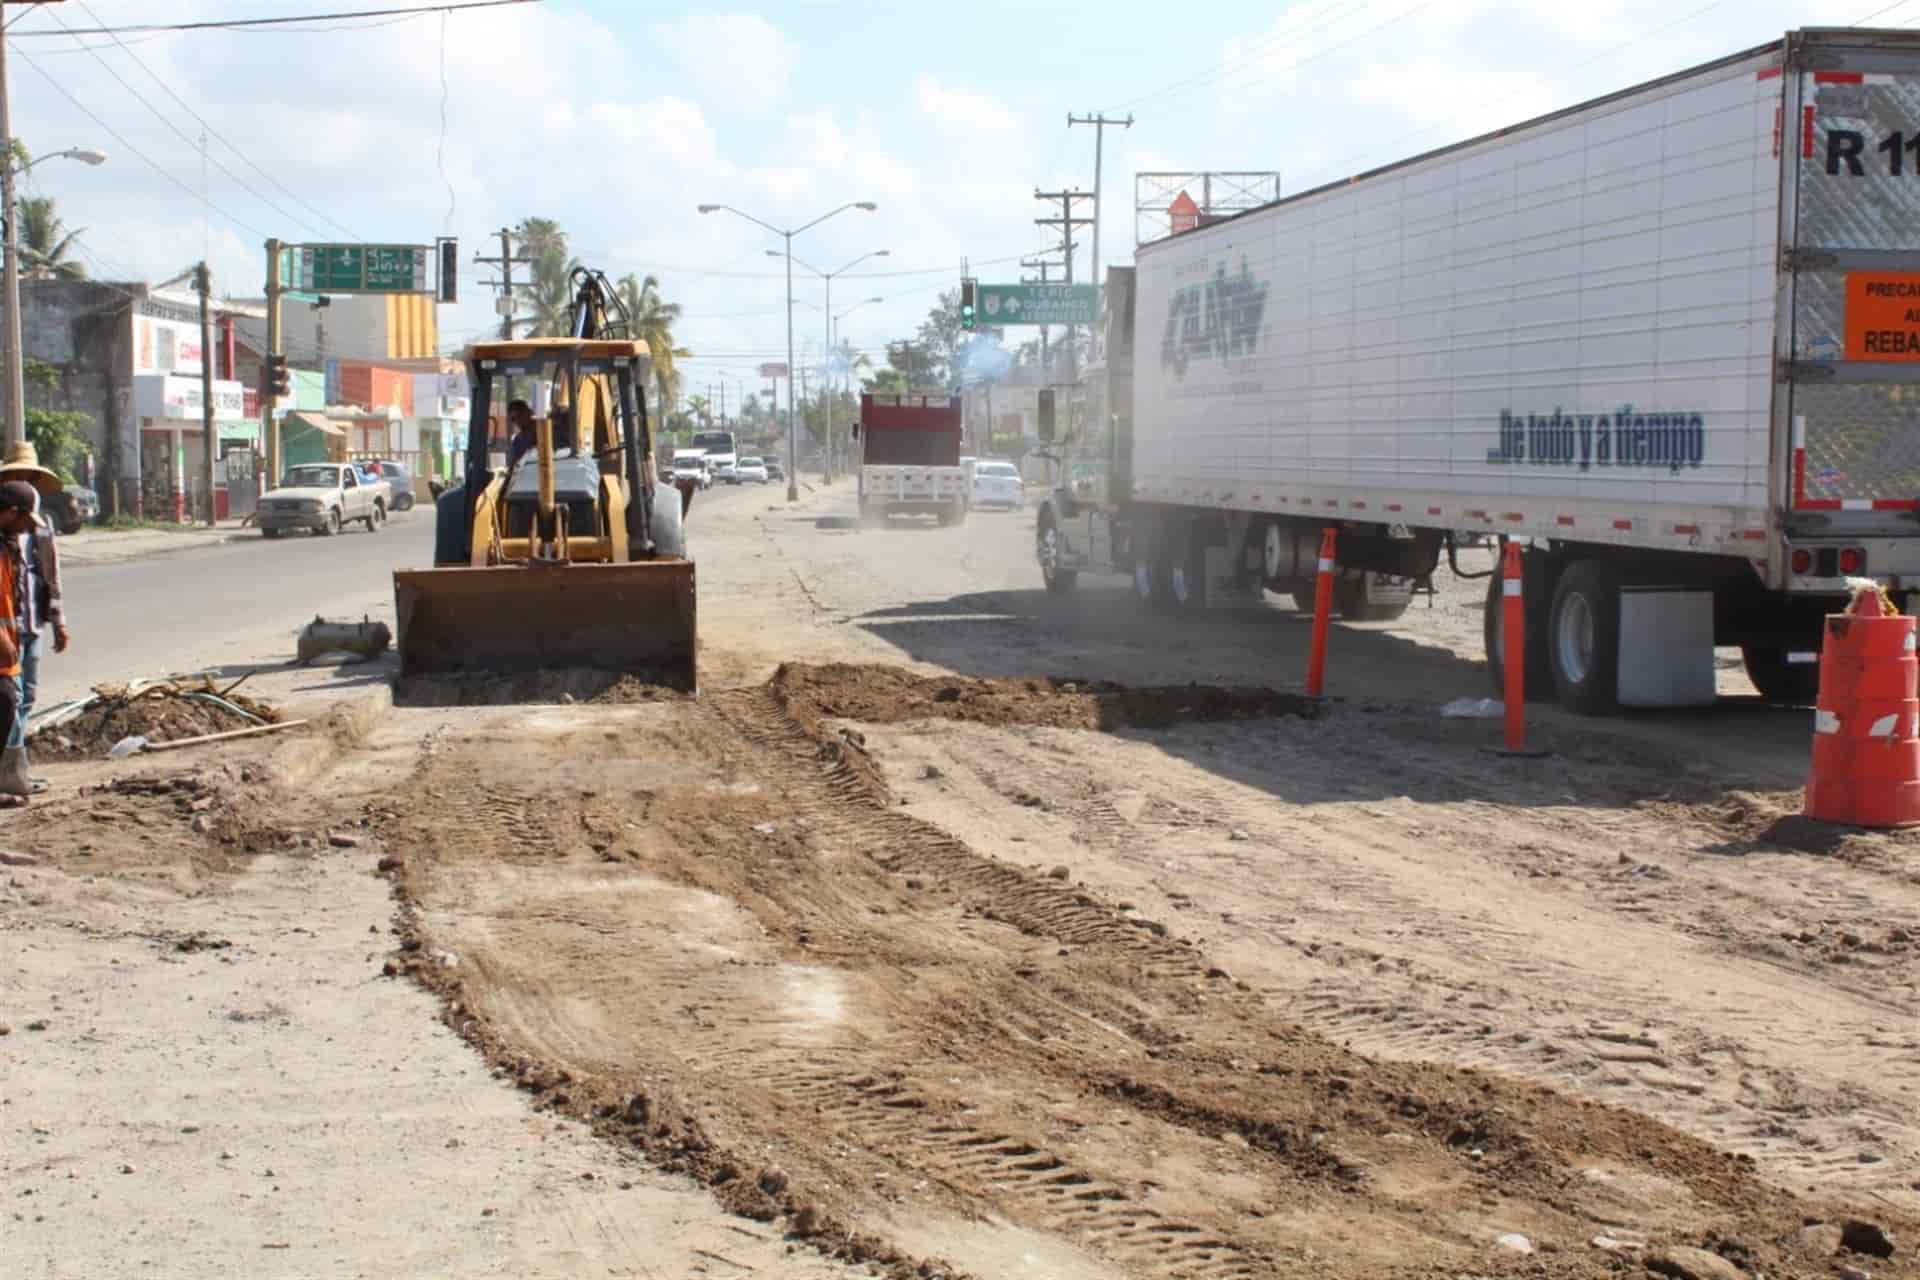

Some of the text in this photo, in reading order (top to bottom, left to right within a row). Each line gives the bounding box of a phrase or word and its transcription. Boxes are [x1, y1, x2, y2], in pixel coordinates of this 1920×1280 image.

[1825, 130, 1865, 176] R
[1865, 281, 1920, 297] PRECA
[1528, 406, 1574, 466] todo
[1578, 414, 1594, 472] y
[1597, 414, 1613, 467] a
[1615, 404, 1704, 476] tiempo
